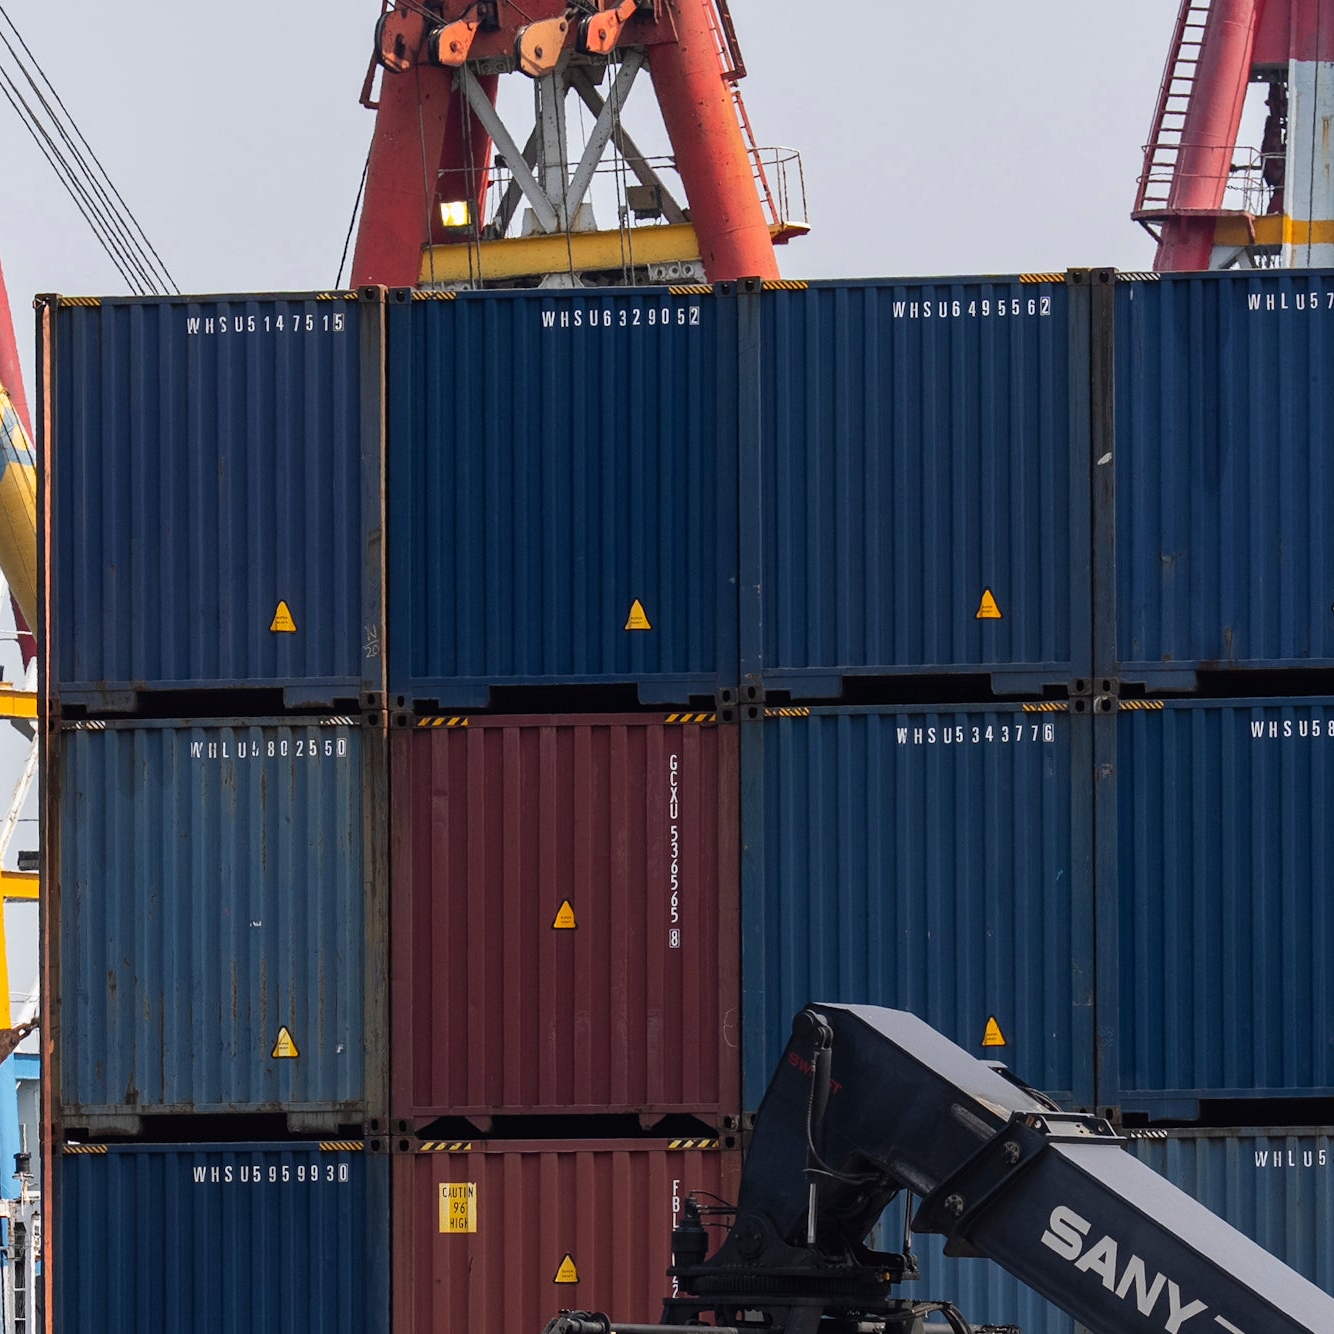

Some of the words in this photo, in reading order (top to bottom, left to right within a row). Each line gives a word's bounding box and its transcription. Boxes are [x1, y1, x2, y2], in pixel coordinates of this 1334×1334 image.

[542, 307, 699, 327] WHSU6329052
[893, 297, 1050, 318] WHSU6495562
[187, 314, 344, 334] WHSU5147515
[897, 724, 1054, 744] WHSU5343776
[670, 755, 678, 819] GCXU
[670, 929, 679, 948] 8
[194, 1164, 348, 1182] WHSU5959930
